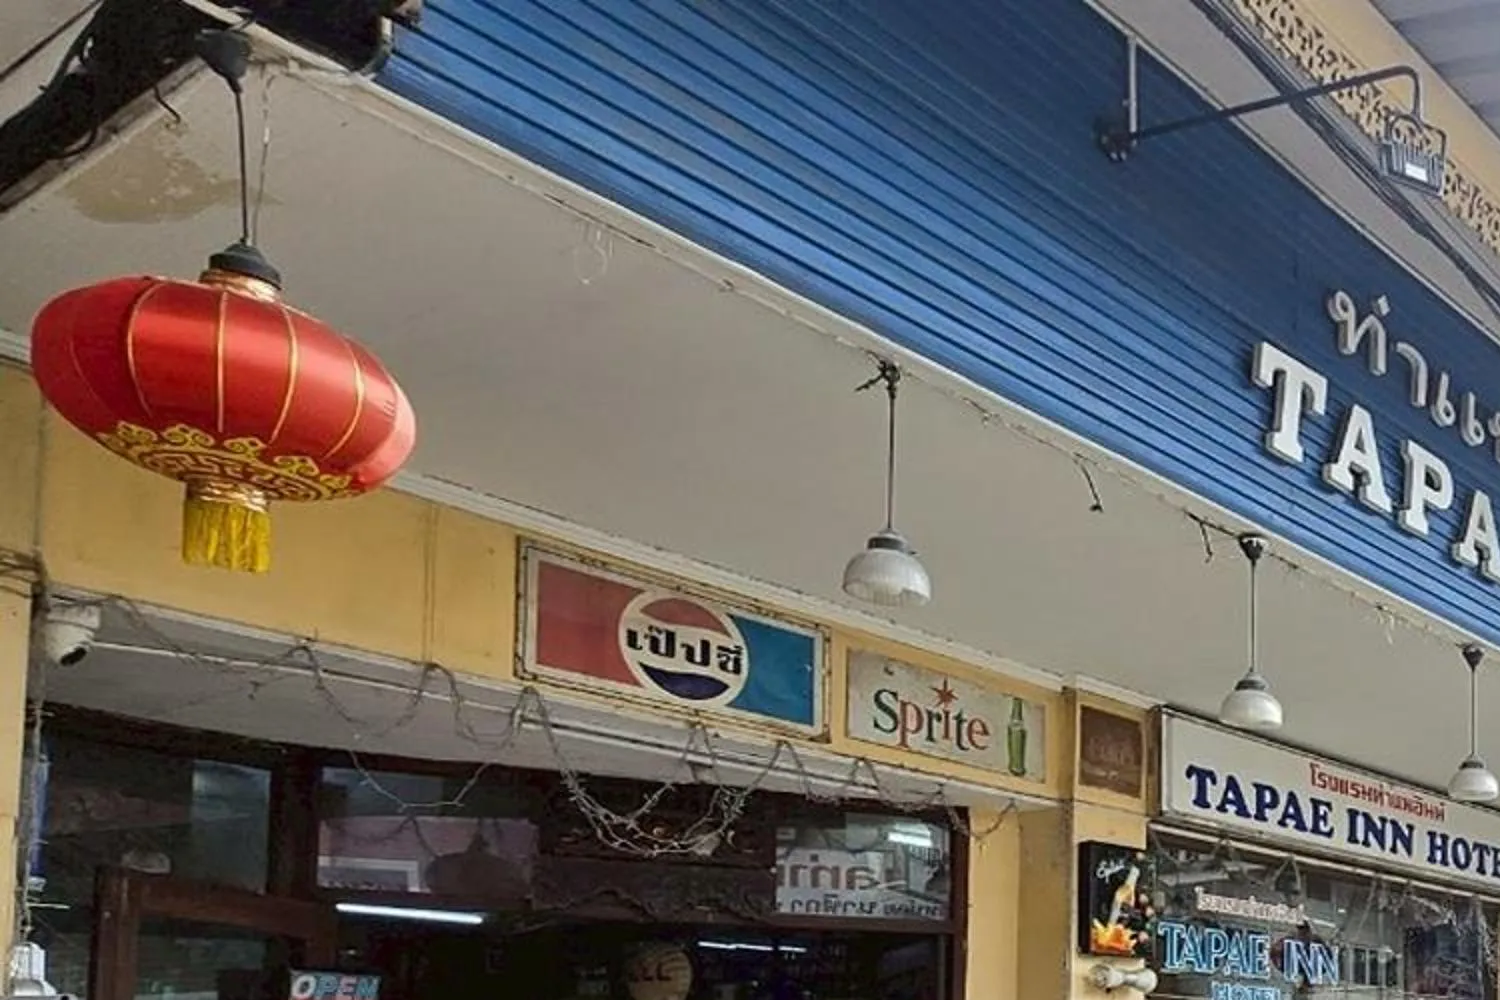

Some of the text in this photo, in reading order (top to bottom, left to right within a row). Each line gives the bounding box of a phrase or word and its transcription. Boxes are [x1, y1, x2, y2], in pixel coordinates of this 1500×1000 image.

[873, 687, 990, 751] Sprite
[1185, 763, 1336, 840] TAPAE
[1346, 808, 1416, 858] INN
[1157, 920, 1340, 986] TAPAE INN
